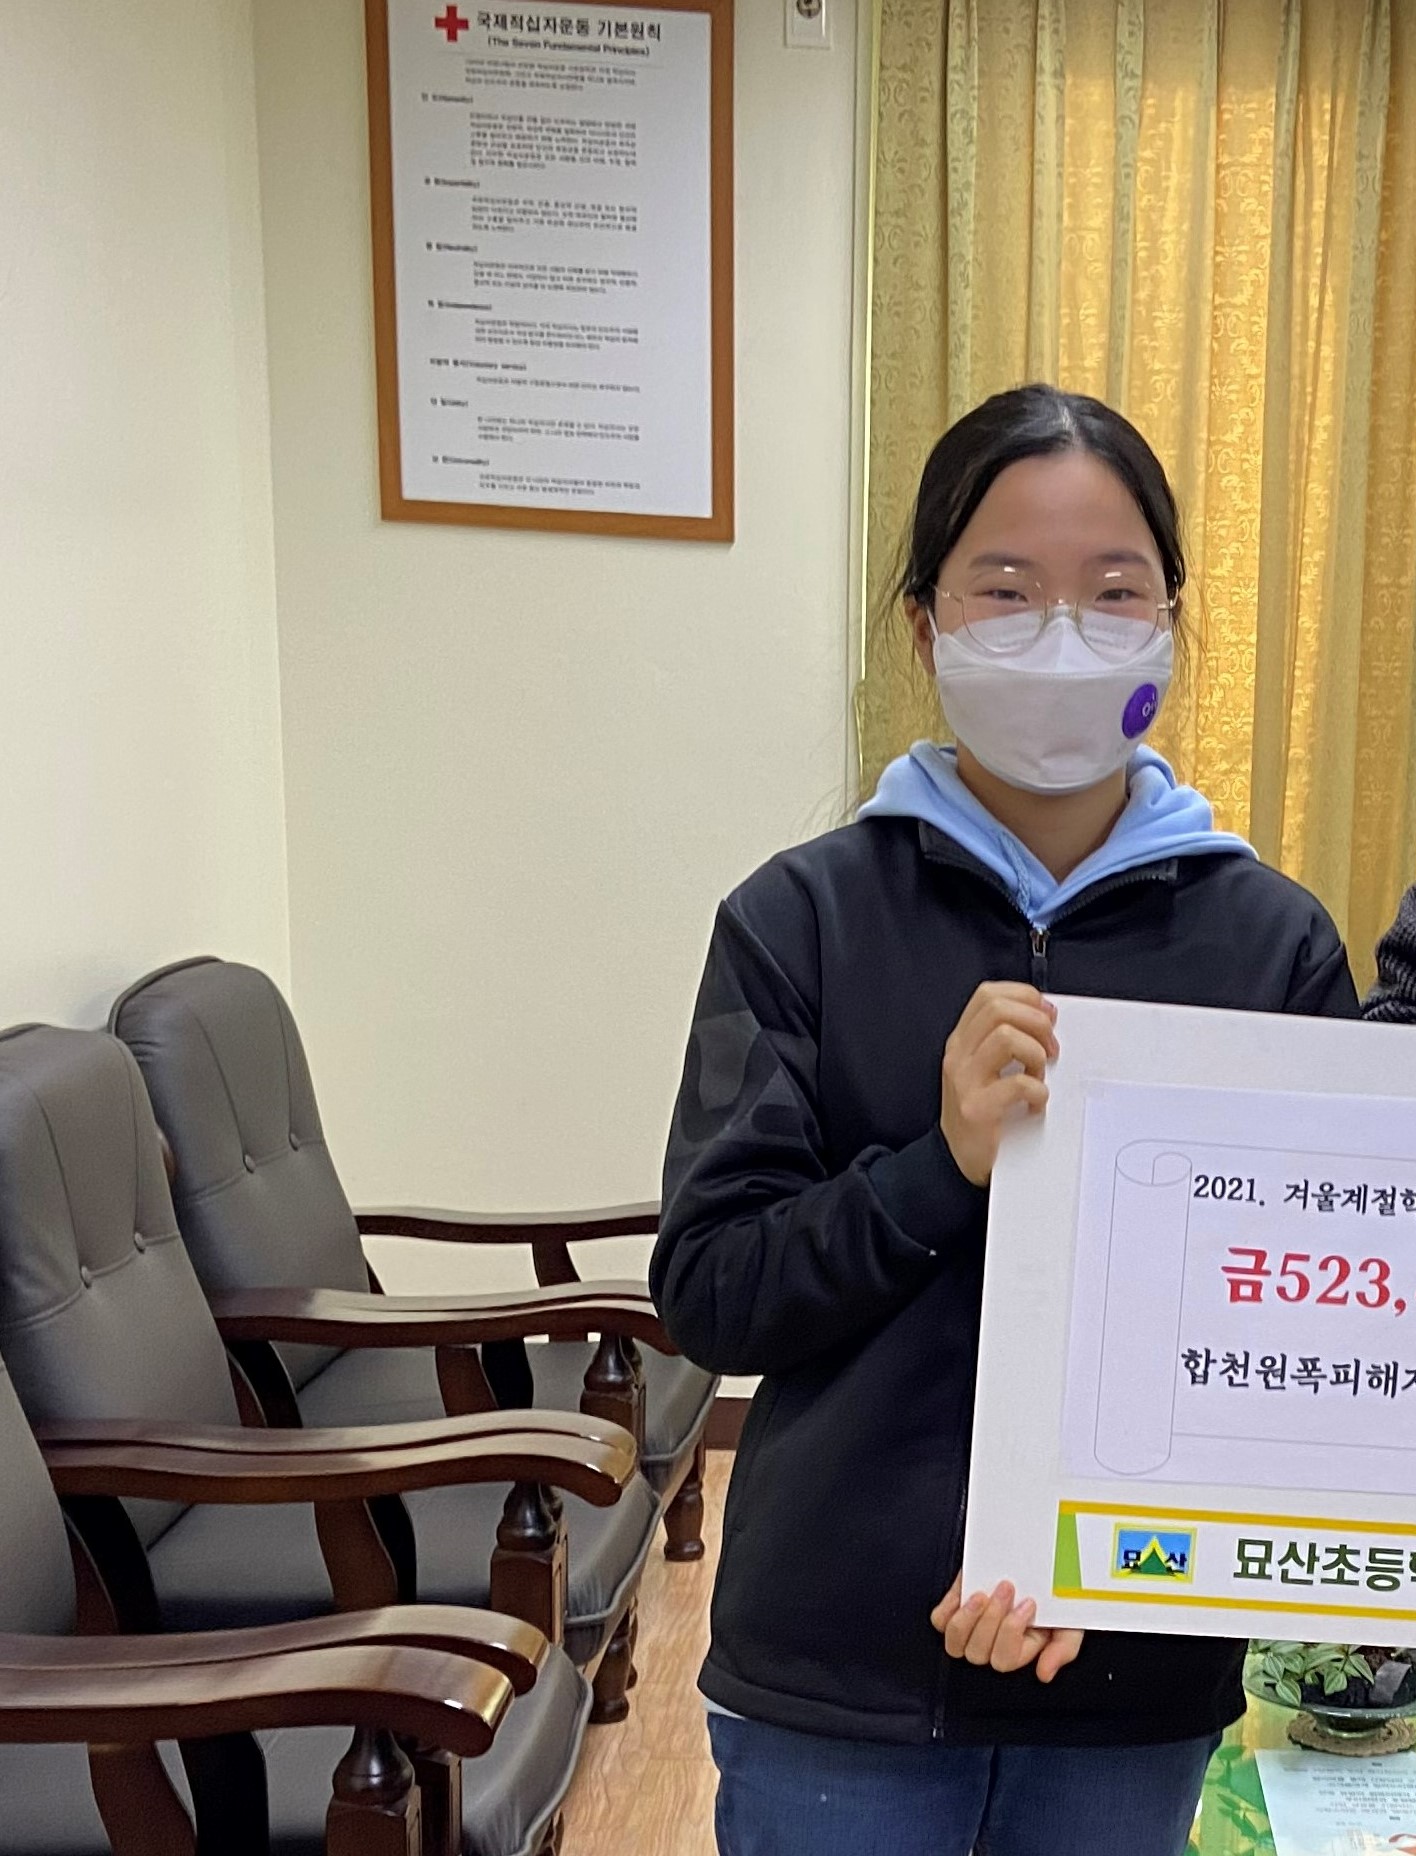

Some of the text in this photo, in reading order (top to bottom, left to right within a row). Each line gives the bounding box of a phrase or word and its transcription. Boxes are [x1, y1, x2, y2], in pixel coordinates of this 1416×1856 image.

[477, 10, 662, 42] 국제적십자운동 기본원칙
[1193, 1174, 1265, 1207] 2021.
